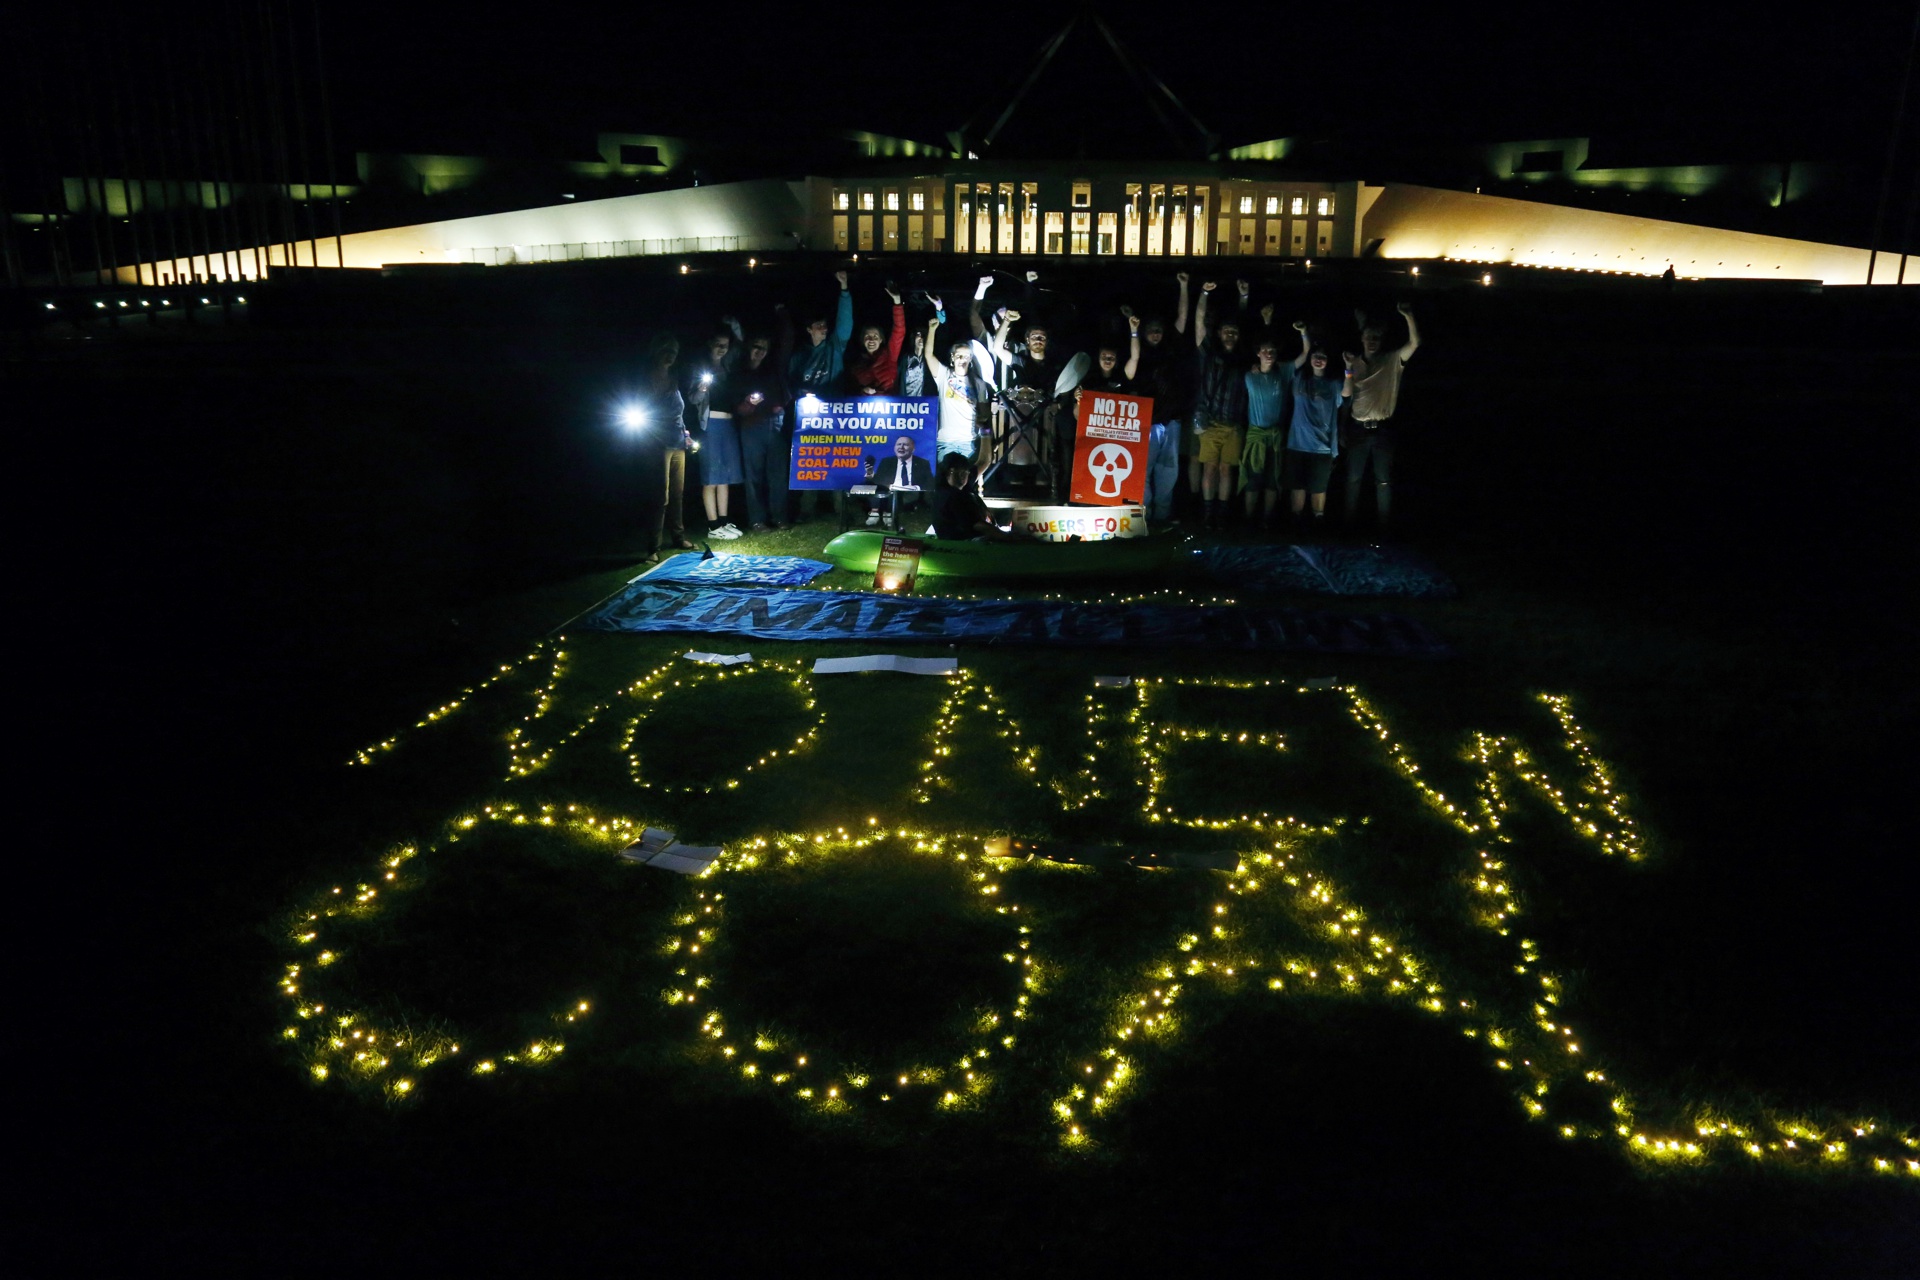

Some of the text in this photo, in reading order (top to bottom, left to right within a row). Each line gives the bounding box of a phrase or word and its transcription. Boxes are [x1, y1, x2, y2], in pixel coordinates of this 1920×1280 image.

[803, 402, 929, 415] WE'RE WAITING
[1094, 398, 1139, 417] NO TO
[801, 417, 924, 430] FOR YOU ALBO!
[1088, 413, 1141, 431] NUCLEAR
[800, 435, 887, 444] WHEN WILL YOU
[798, 446, 862, 456] STOP NEW
[797, 458, 859, 468] COAL AND
[796, 470, 828, 481] GAS?
[1027, 517, 1132, 533] QUEERS FOR
[895, 552, 910, 560] heat
[913, 666, 1644, 862] NEW
